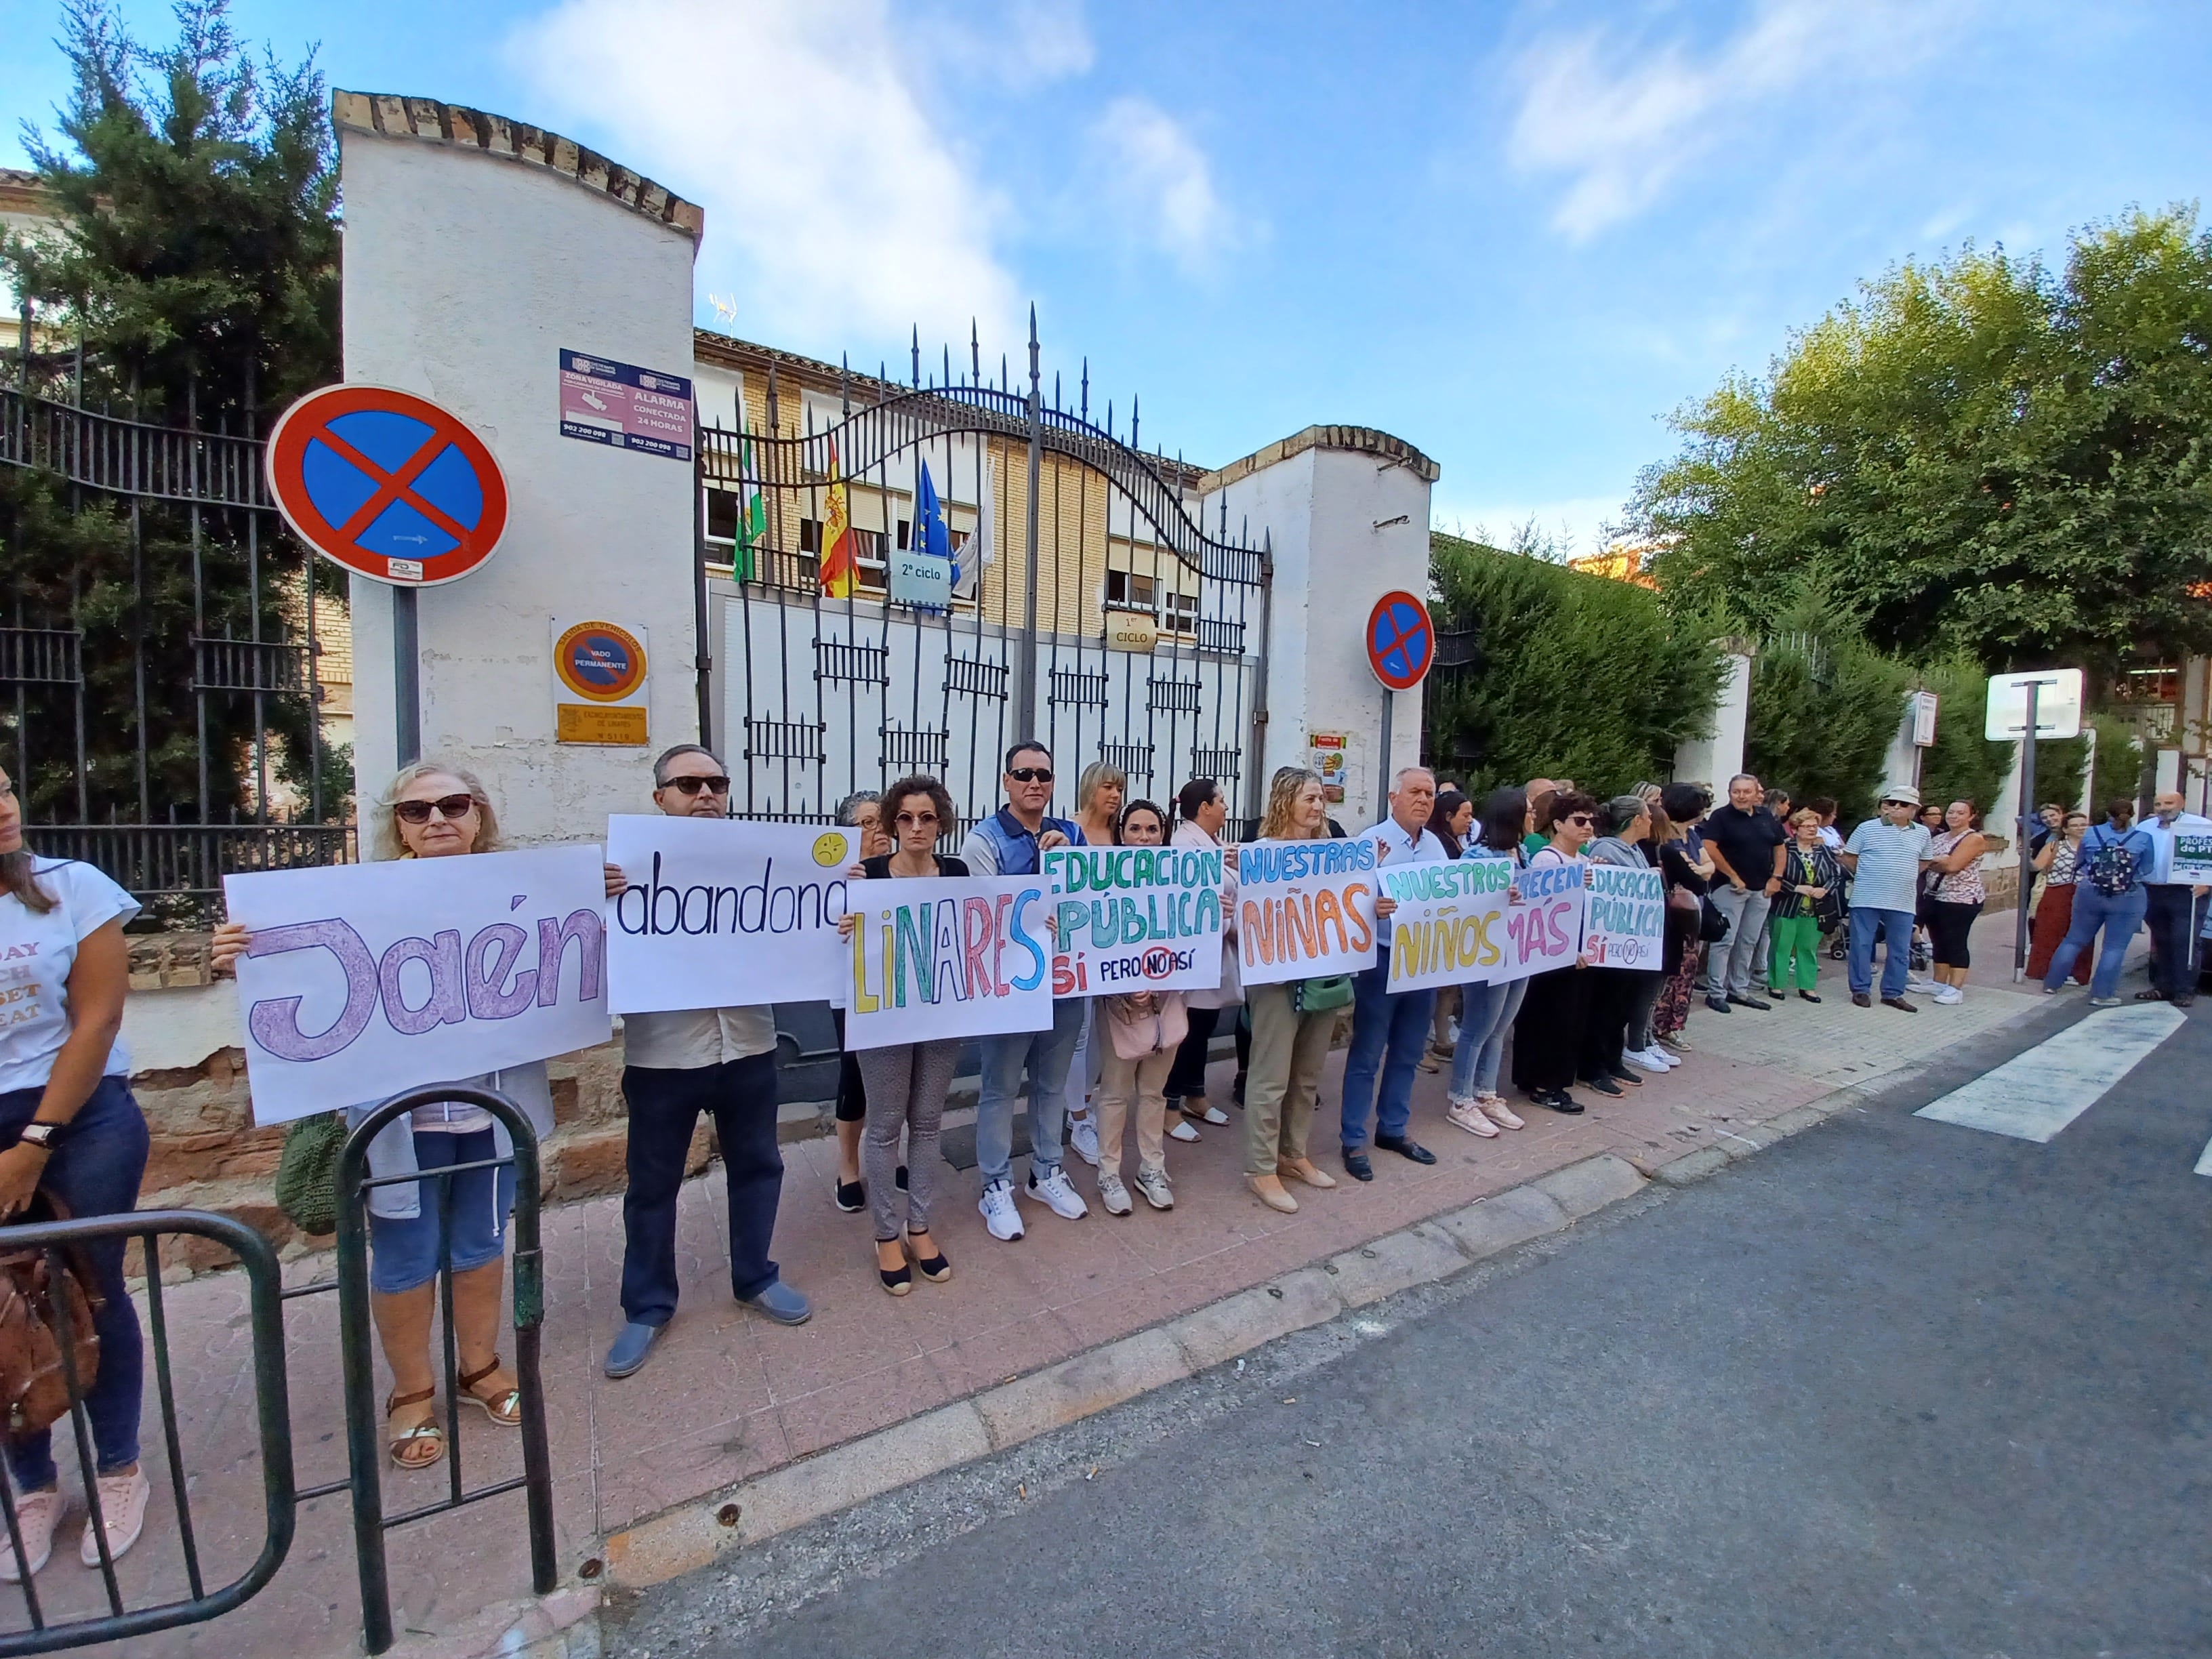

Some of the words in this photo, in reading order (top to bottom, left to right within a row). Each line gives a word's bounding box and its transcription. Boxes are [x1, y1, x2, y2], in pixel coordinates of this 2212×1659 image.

[565, 372, 587, 383] ZONA
[588, 377, 622, 391] VIGILADA
[634, 392, 685, 411] ALARMA
[633, 405, 687, 422] CONECTADA
[563, 424, 577, 432] 902
[578, 426, 592, 434] 200
[637, 417, 649, 426] 24
[650, 419, 683, 432] HORAS
[631, 437, 644, 445] 902
[644, 440, 658, 448] 200
[916, 567, 941, 580] ciclo
[558, 622, 583, 646] SALIDA
[1116, 632, 1147, 642] CICLO
[575, 659, 627, 670] PERMANENTE
[2180, 844, 2196, 853] de
[1240, 840, 1375, 886] NUESTRAS
[1387, 861, 1511, 903] NUESTROS
[1513, 863, 1583, 900] RECEN
[1057, 888, 1219, 953] PÚBLICA
[1590, 897, 1663, 938] PÚBLICA
[1507, 897, 1572, 966] MÁS
[1586, 935, 1608, 963] SÍ
[1101, 956, 1141, 982] PERO
[1145, 952, 1167, 975] NO
[1169, 948, 1196, 972] ASÍ
[247, 895, 601, 1062] Jaén
